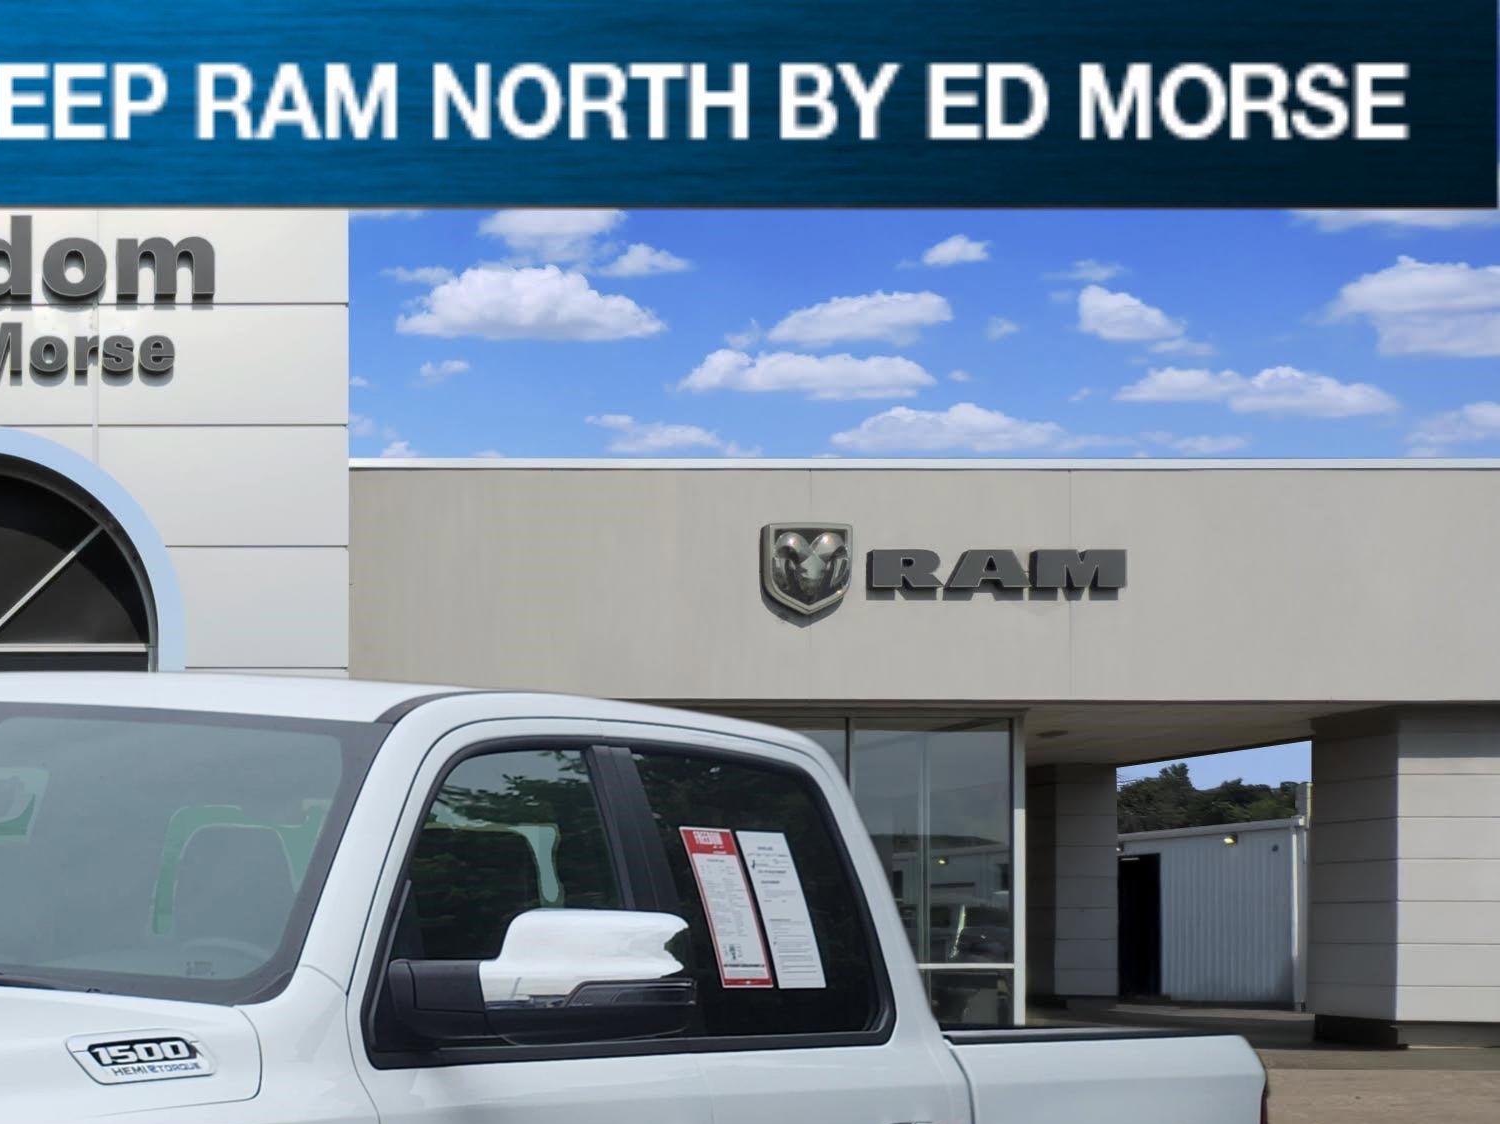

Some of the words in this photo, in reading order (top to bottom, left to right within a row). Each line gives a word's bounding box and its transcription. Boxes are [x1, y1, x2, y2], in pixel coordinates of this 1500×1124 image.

[866, 548, 1128, 590] RAM
[93, 1039, 191, 1066] 1500
[111, 1065, 148, 1077] HEMI
